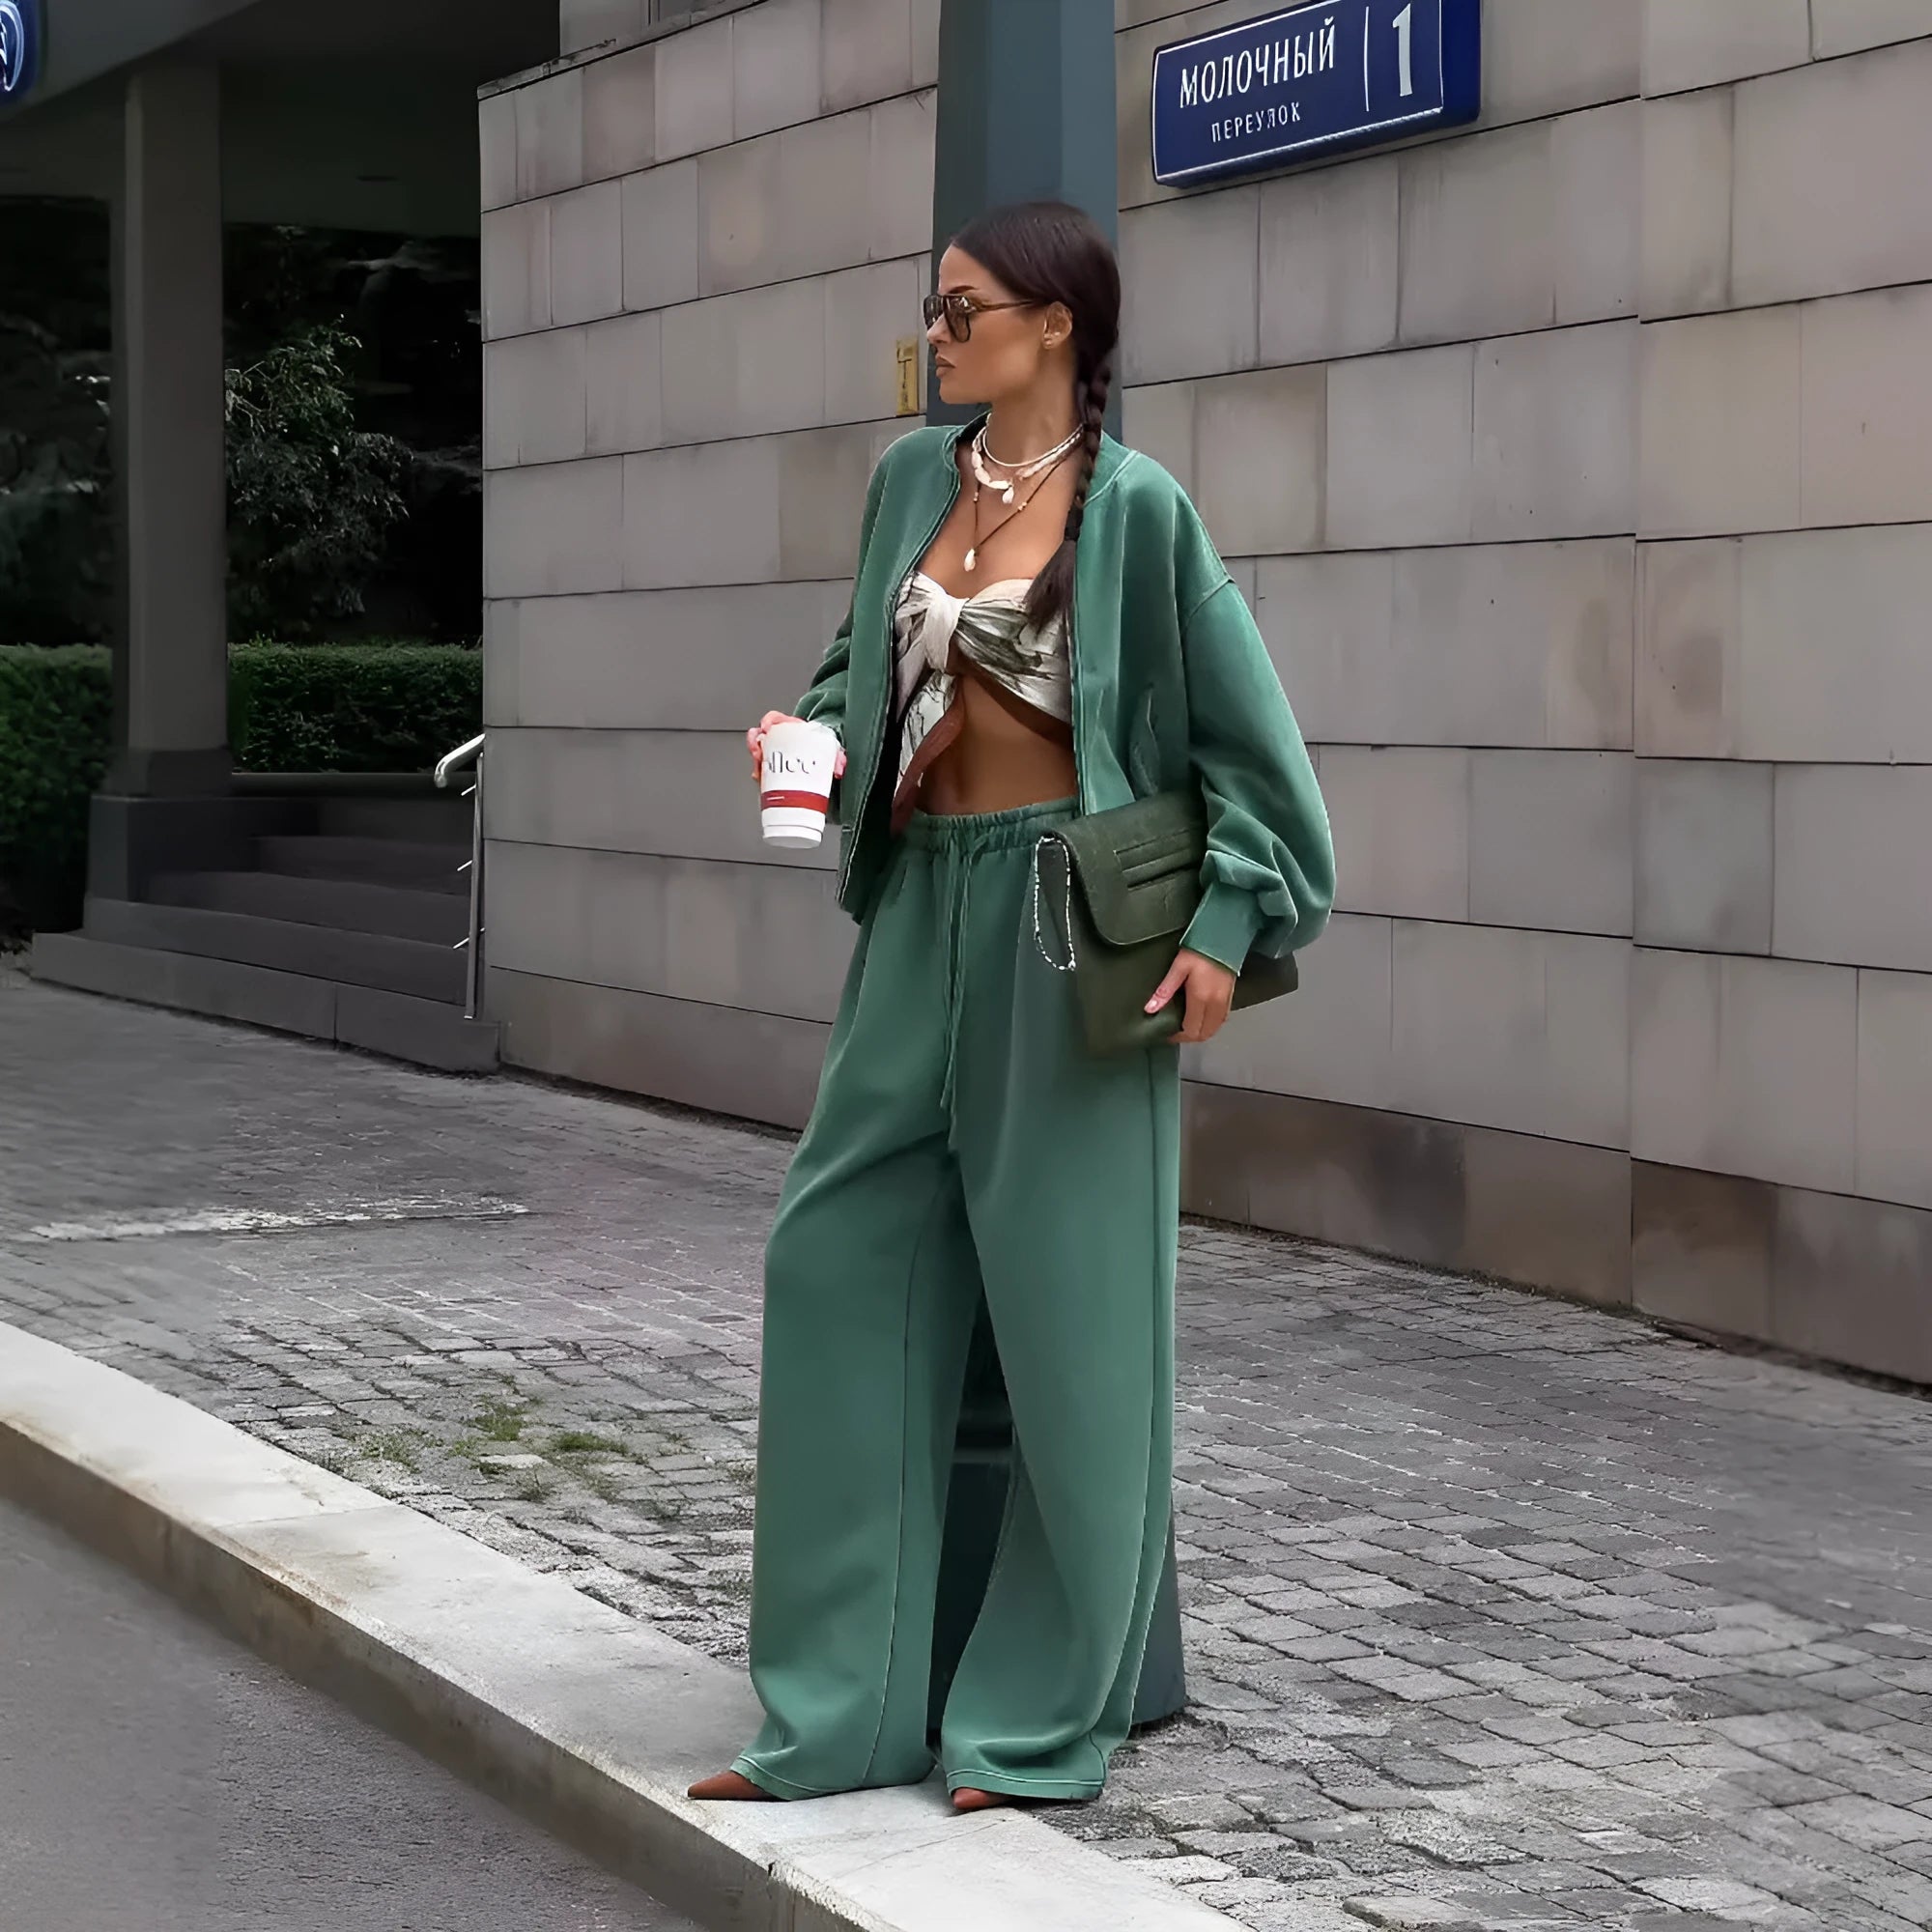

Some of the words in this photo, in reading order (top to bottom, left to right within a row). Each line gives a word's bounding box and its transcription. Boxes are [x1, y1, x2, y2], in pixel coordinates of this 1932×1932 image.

[1179, 16, 1336, 108] МОЛОЧНЫЙ
[1392, 3, 1413, 97] 1
[1211, 101, 1302, 143] ПЕРЕУЛОК
